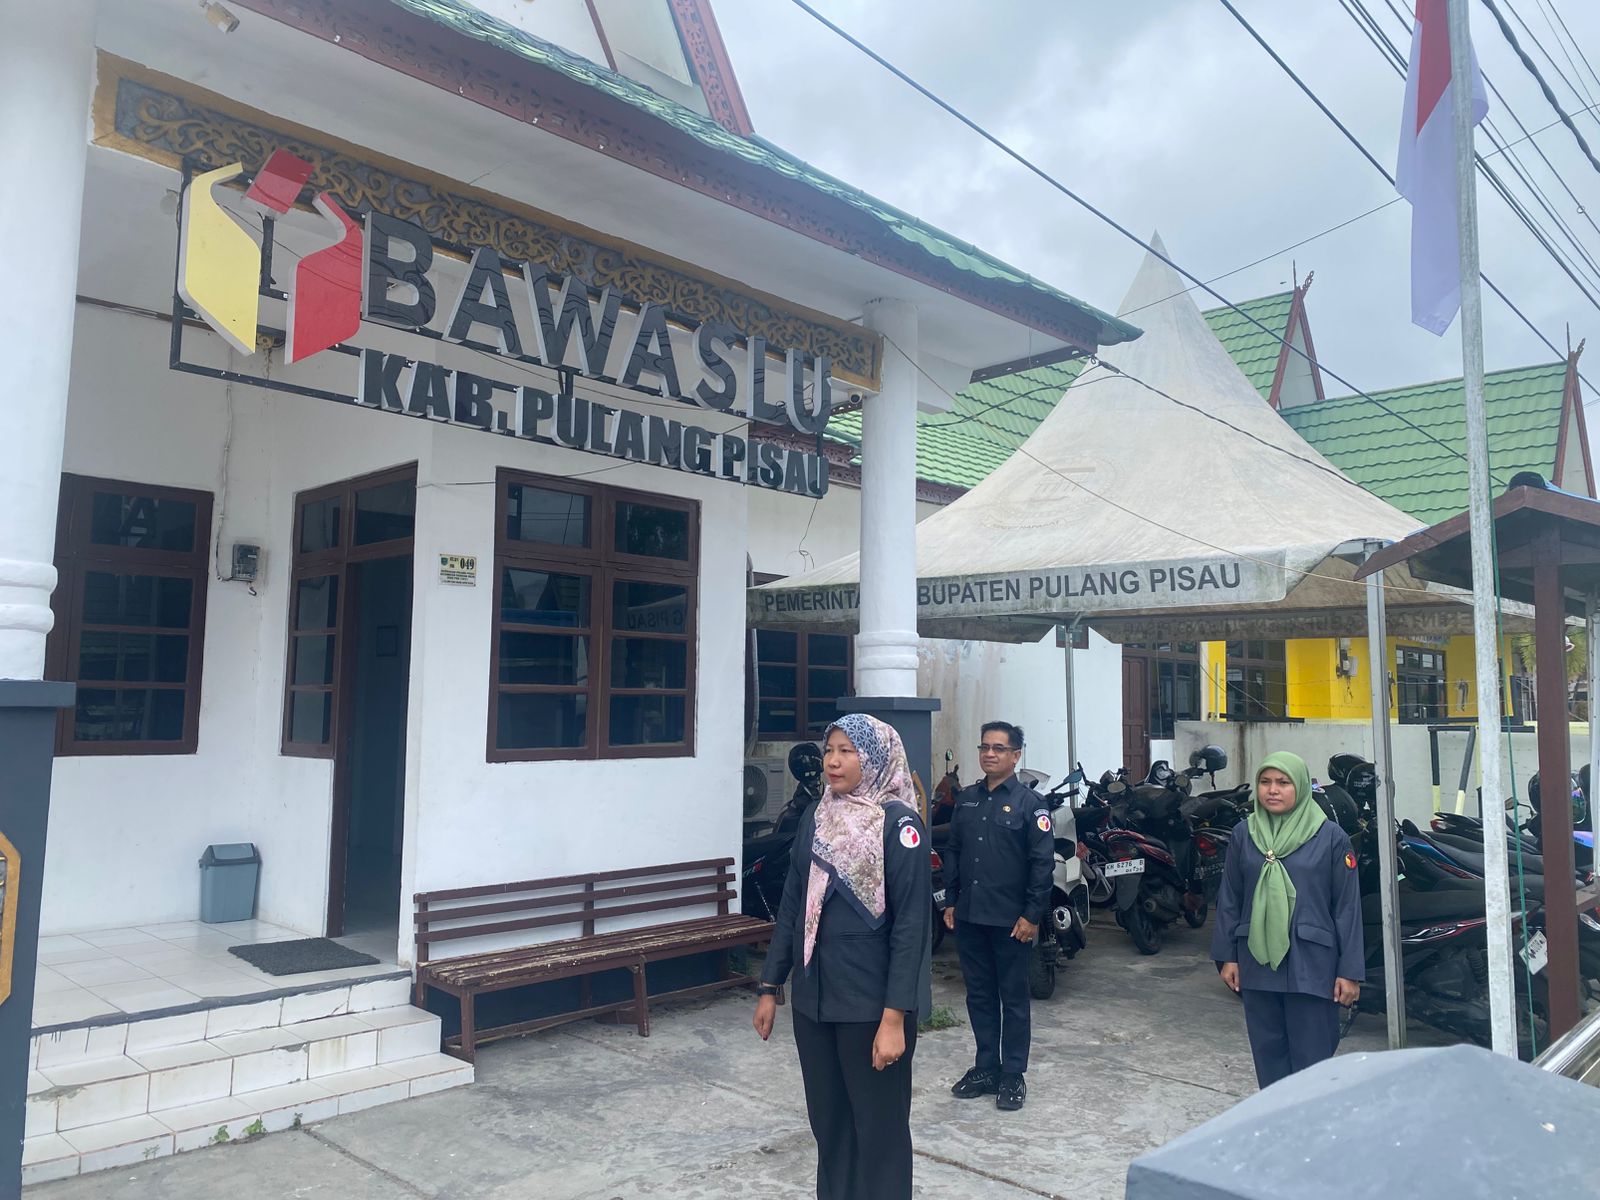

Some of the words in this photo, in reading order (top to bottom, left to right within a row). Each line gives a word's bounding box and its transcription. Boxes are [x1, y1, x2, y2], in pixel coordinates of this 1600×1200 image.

[362, 210, 832, 433] BAWASLU
[358, 348, 508, 432] KAB.
[515, 386, 712, 474] PULANG
[715, 434, 829, 497] PISAU
[1029, 570, 1140, 599] PULANG
[1150, 563, 1241, 592] PISAU
